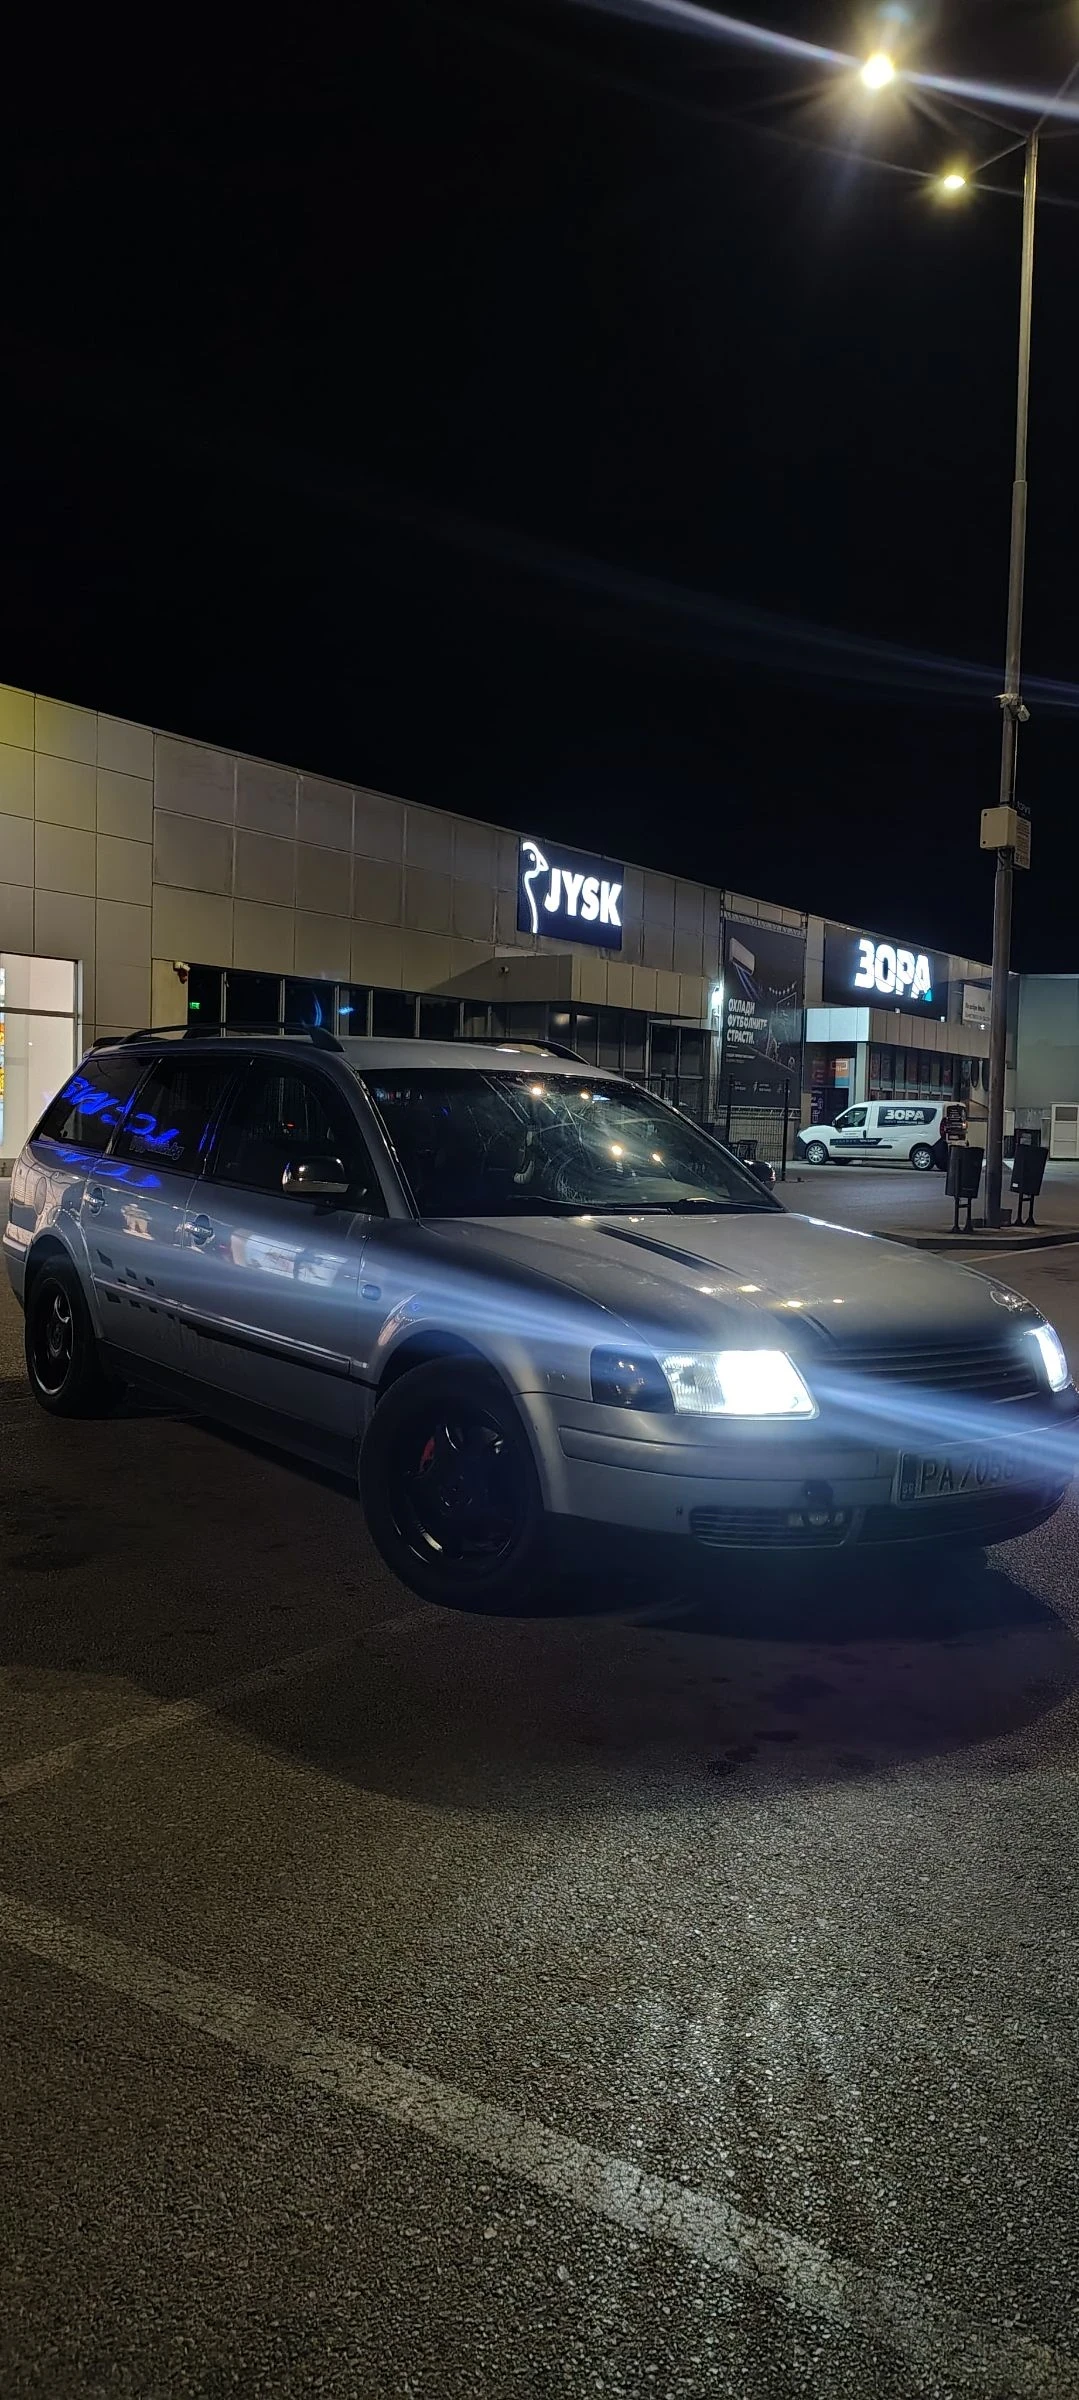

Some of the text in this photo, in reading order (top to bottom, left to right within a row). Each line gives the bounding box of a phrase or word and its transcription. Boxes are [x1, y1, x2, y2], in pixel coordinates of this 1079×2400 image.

[544, 868, 622, 927] JYSK
[854, 939, 933, 1002] ЗОРА
[728, 998, 756, 1016] ОХЛАДИ
[726, 1029, 755, 1045] СТРАСТИ.
[884, 1109, 925, 1121] ЗОРА
